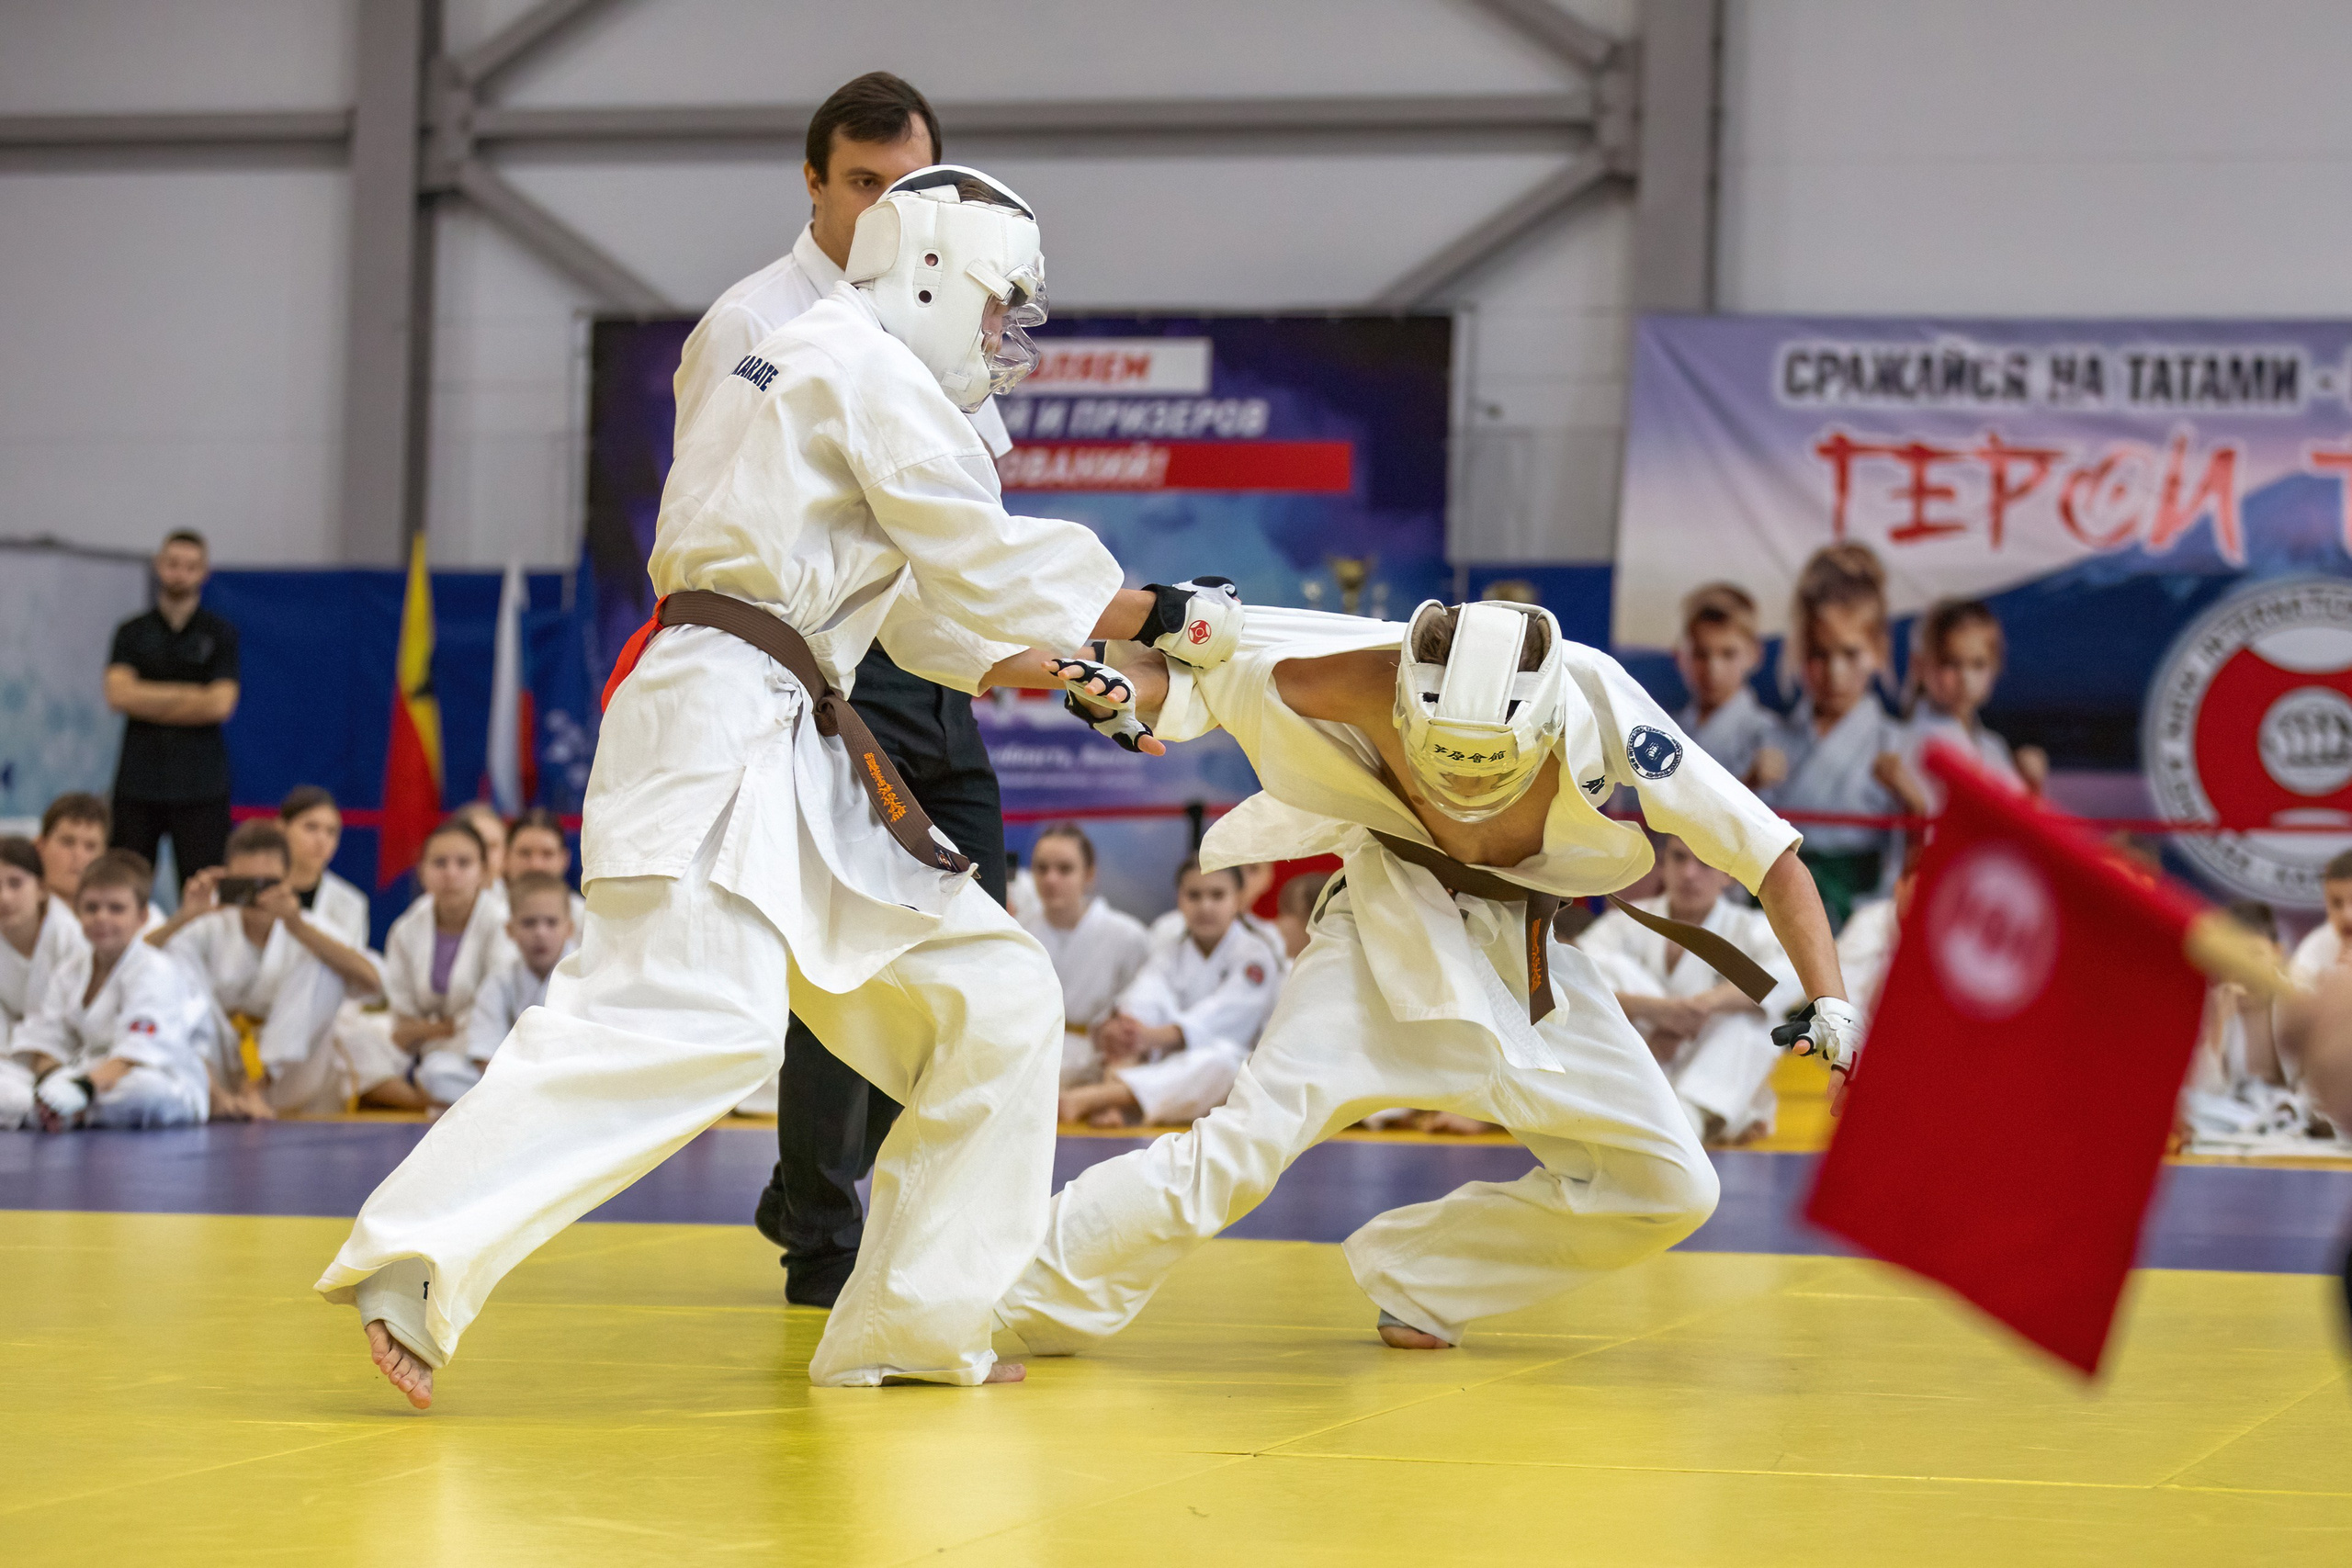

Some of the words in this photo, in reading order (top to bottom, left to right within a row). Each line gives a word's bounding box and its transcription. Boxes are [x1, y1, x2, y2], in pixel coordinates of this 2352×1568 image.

[1784, 344, 2028, 400] СРАЖАЙСЯ
[2047, 353, 2106, 401] НА
[2124, 353, 2301, 403] ТАТАМИ
[1069, 398, 1270, 439] ПРИЗЕРОВ
[1815, 432, 2244, 566] ГЕРОИ
